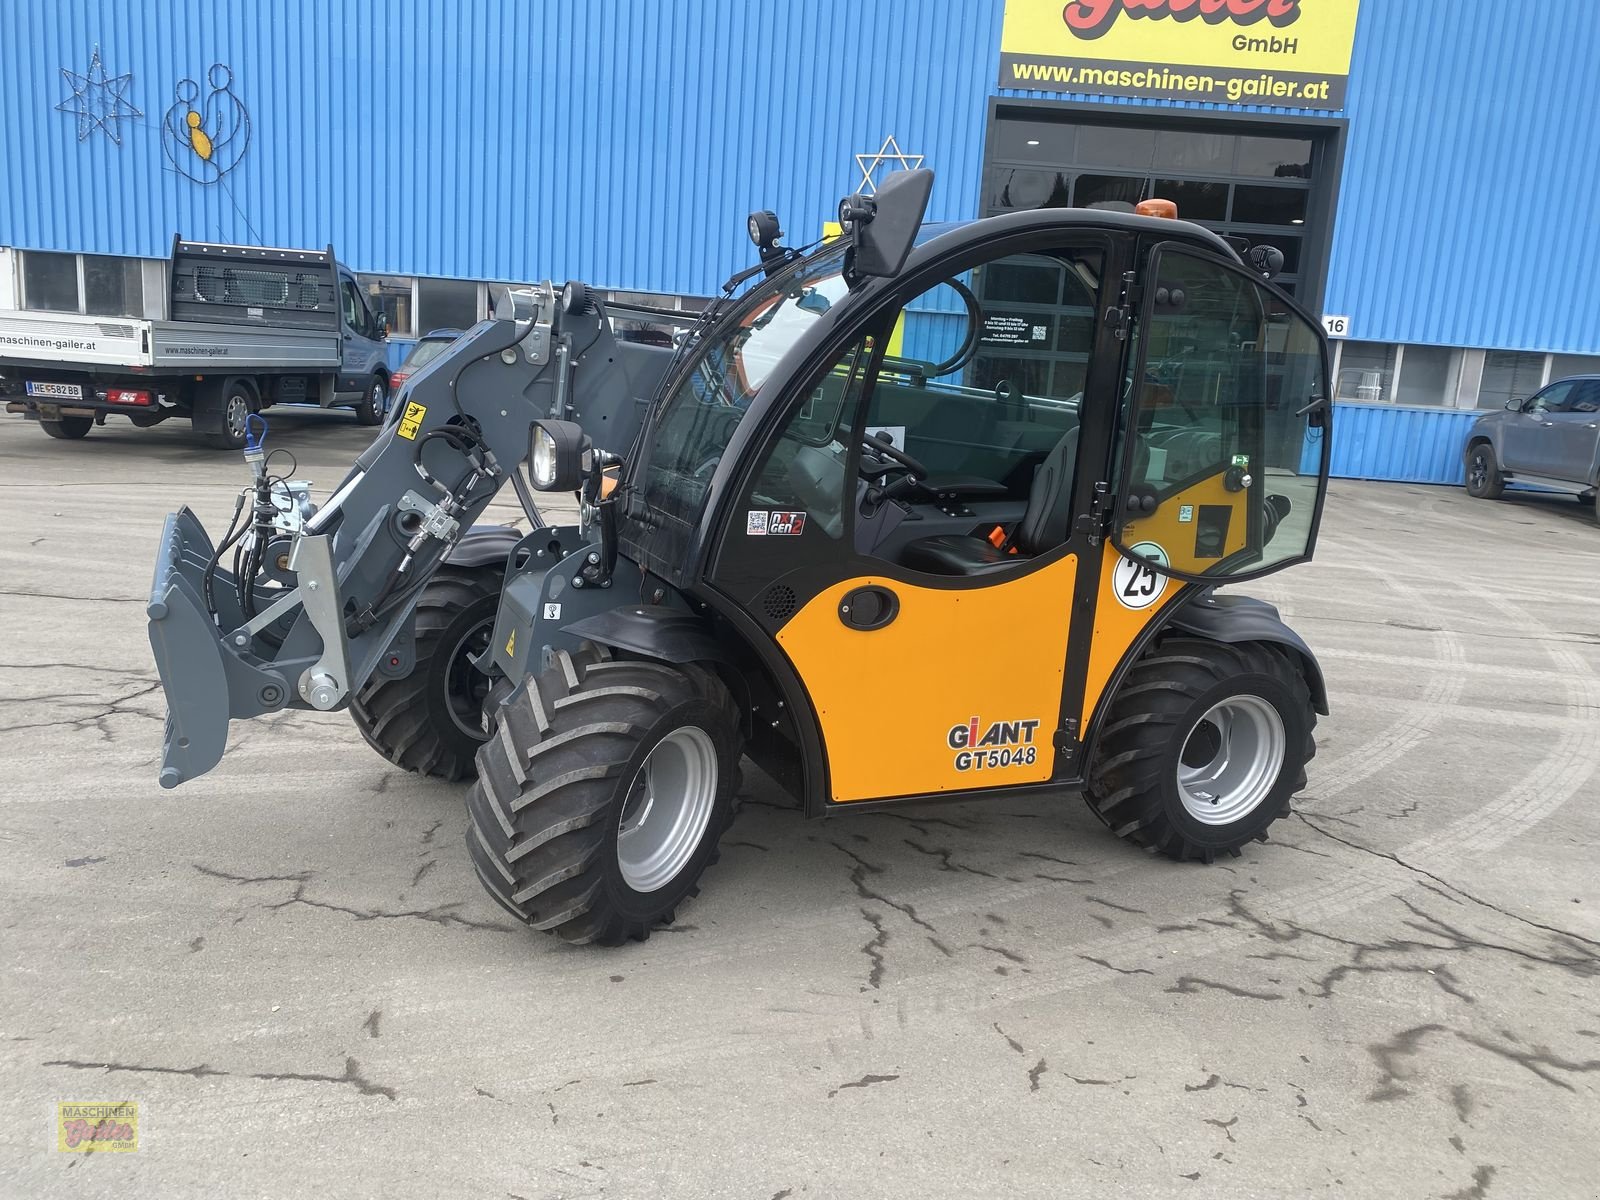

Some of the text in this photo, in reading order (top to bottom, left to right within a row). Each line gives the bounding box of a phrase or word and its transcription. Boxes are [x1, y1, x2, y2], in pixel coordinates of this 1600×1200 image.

[1231, 34, 1298, 54] GmbH
[1012, 62, 1329, 100] www.maschinen-gailer.at
[1327, 319, 1344, 333] 16
[165, 346, 228, 356] www.maschinen-gailer.at
[1123, 554, 1161, 597] 25
[955, 747, 1036, 771] GT5048
